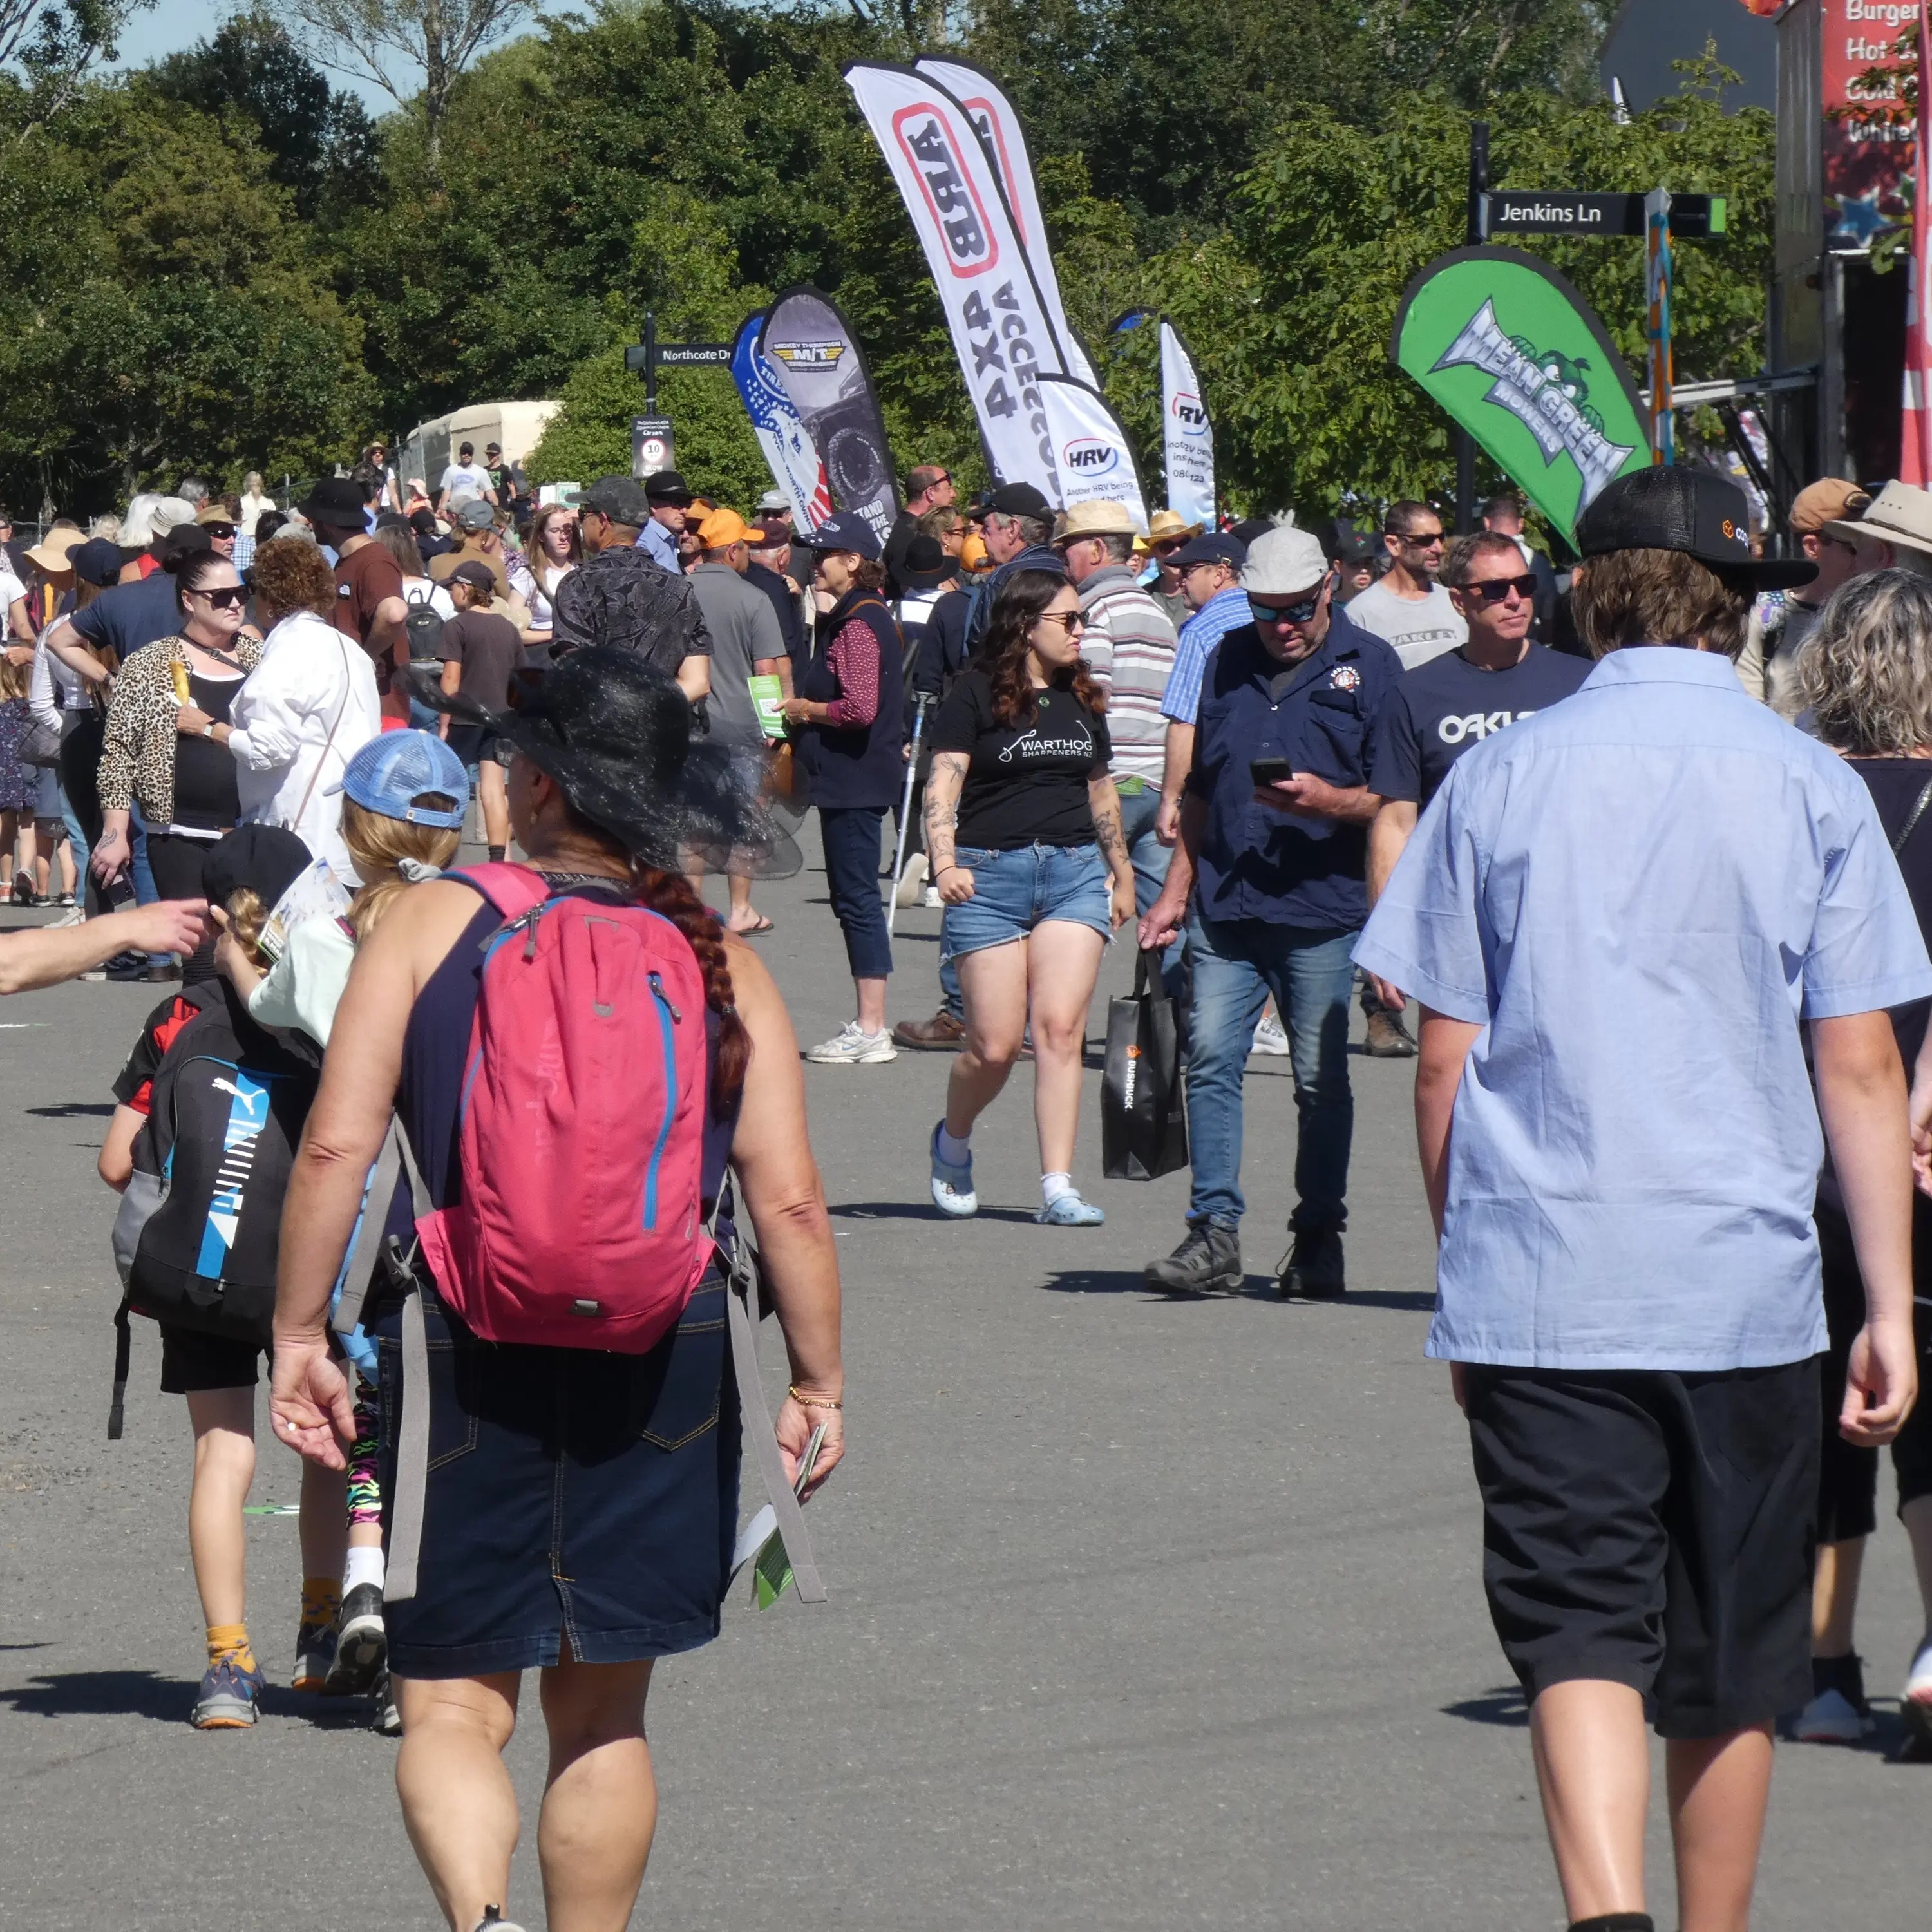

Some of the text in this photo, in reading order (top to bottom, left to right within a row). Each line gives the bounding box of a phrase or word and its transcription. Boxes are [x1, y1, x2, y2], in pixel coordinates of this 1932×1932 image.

[1846, 36, 1888, 61] Hot
[1499, 203, 1602, 222] Jenkins Ln
[663, 349, 717, 361] Northcote
[793, 348, 828, 362] M/T
[1431, 298, 1636, 516] MEAN GREEN
[1494, 384, 1560, 454] MOWERS
[647, 444, 660, 453] 10
[1069, 446, 1112, 468] HRV
[1067, 482, 1133, 497] Another HRV being
[1021, 739, 1092, 751] WARTHOG
[1022, 749, 1082, 758] SHARPENERS
